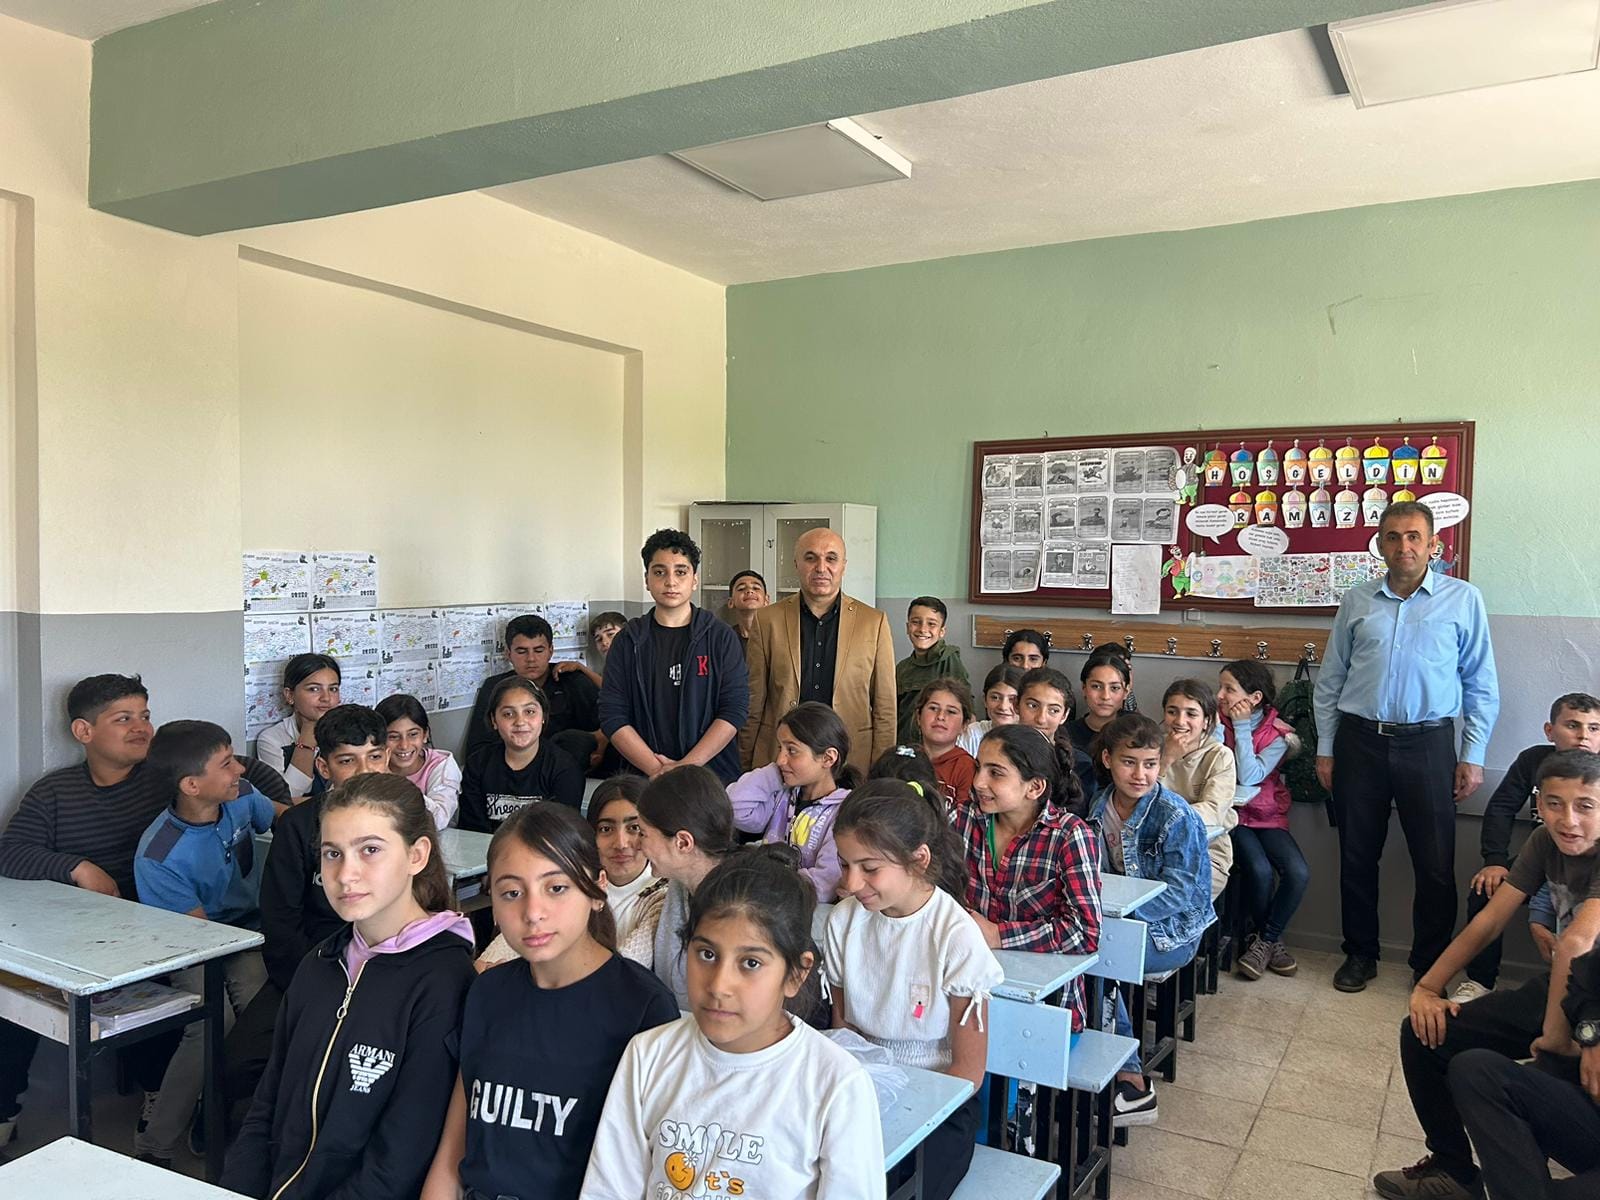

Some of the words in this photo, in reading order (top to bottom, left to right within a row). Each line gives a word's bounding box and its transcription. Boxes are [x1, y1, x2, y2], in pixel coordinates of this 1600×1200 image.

[1211, 465, 1437, 481] HOŞGELDİN
[1237, 510, 1379, 522] RAMAZA
[349, 1043, 396, 1063] ARMANI
[349, 1084, 371, 1094] JEANS
[470, 1079, 578, 1136] GUILTY
